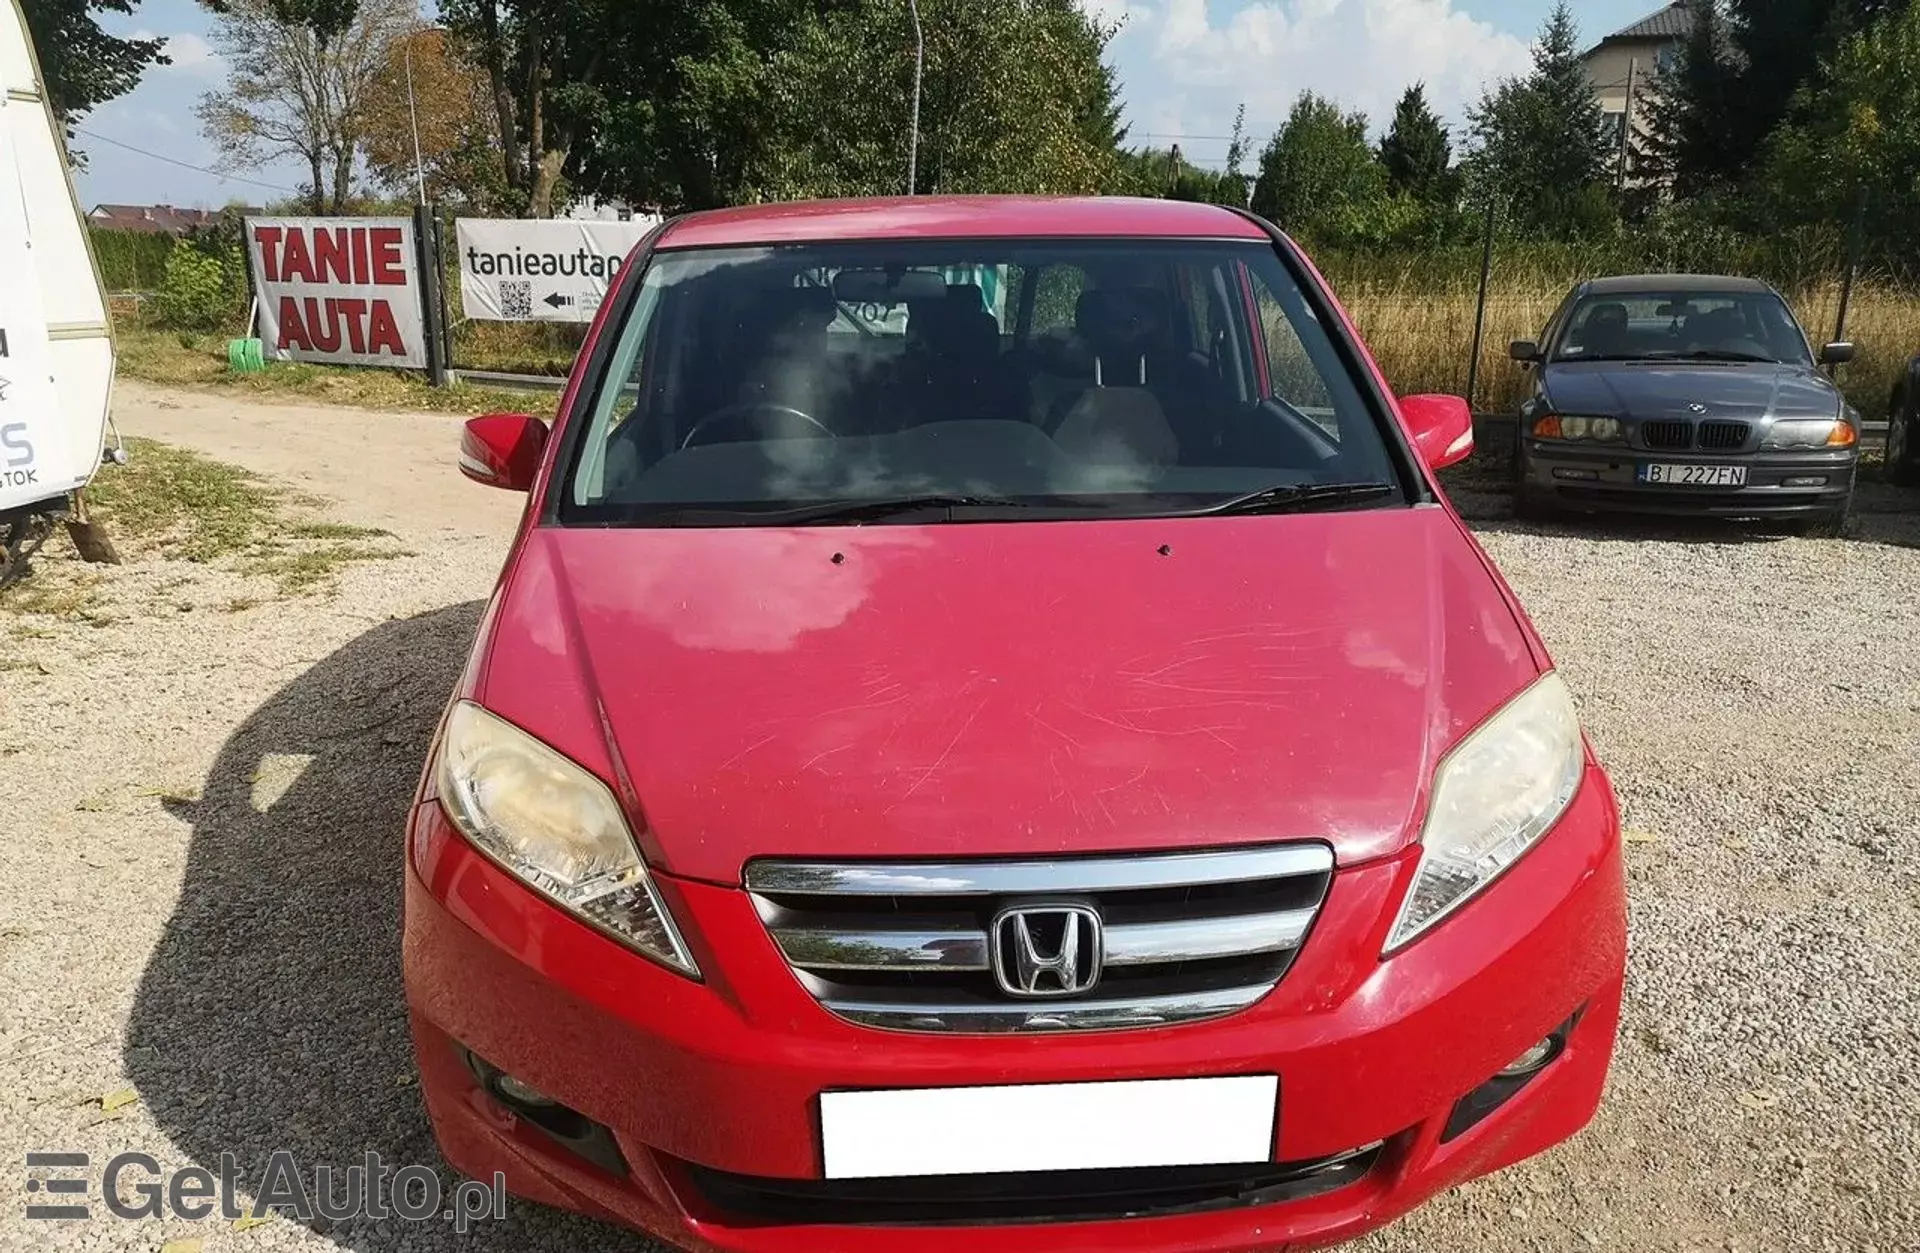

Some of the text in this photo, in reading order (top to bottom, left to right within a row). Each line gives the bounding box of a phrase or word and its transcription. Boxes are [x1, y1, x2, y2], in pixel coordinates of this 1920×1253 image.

[254, 226, 407, 286] TANIE
[278, 296, 407, 357] AUTA
[0, 469, 39, 488] TOK
[1650, 464, 1671, 483] BI
[1681, 466, 1743, 486] 227FN
